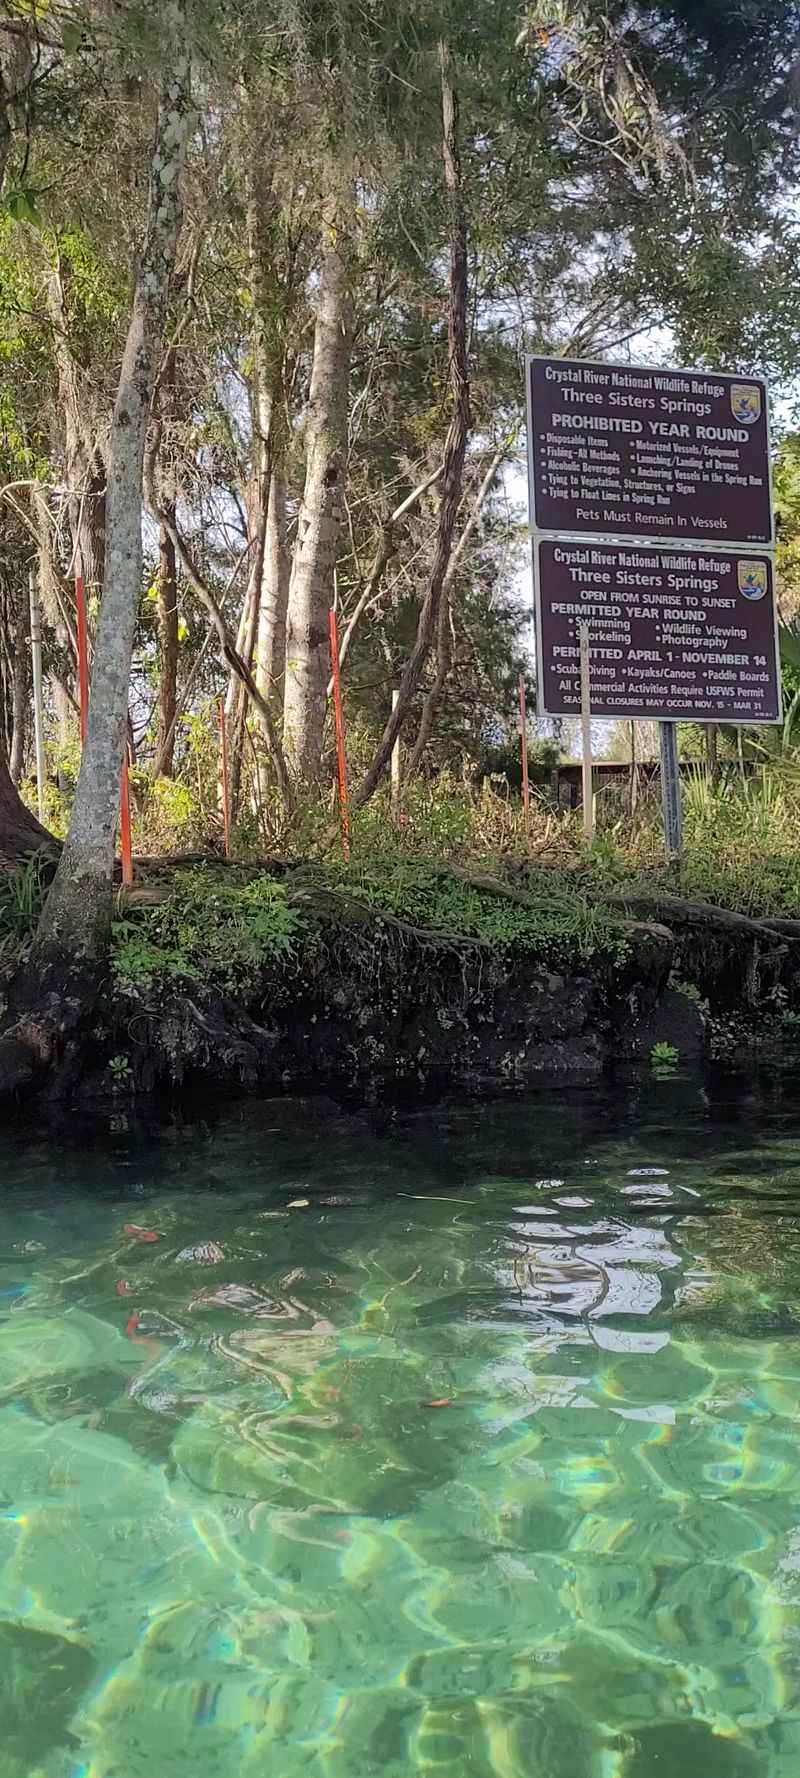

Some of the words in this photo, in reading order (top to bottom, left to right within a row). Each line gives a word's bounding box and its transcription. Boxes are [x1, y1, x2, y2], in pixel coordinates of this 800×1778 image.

[545, 366, 581, 382] Crystal
[584, 370, 609, 384] River
[612, 373, 652, 389] National
[654, 377, 690, 392] Wildlife
[692, 381, 724, 397] Refuge
[561, 388, 602, 404] Three
[608, 392, 655, 408] Sisters
[660, 397, 711, 416] Springs
[552, 414, 643, 433] PROHIBITED
[648, 421, 690, 437] YEAR
[696, 426, 749, 442] ROUND
[546, 432, 586, 445] Disposable
[588, 436, 608, 446] Items
[590, 449, 620, 461] Methods
[636, 440, 671, 452] Motorized
[673, 443, 740, 458] Vessels/Equipment
[548, 460, 580, 471] Alcoholic
[583, 463, 620, 475] Beverages
[637, 453, 703, 470] Launching/Landing
[705, 459, 712, 468] of
[715, 460, 738, 470] Drones
[548, 473, 568, 485] Tying
[571, 476, 578, 484] to
[581, 476, 621, 489] Vegetation,
[676, 483, 695, 494] Signs
[638, 467, 672, 480] Anchoring
[674, 470, 700, 480] Vessels
[702, 472, 709, 481] in
[711, 473, 723, 482] the
[725, 473, 747, 486] Spring
[749, 475, 762, 485] Run
[549, 487, 568, 499] Tying
[571, 489, 579, 498] to
[581, 489, 600, 500] Float
[602, 491, 620, 501] Lines
[623, 492, 630, 502] in
[632, 492, 655, 505] Spring
[657, 495, 670, 504] Run
[576, 508, 600, 520] Pets
[604, 510, 631, 522] Must
[635, 512, 673, 525] Remain
[678, 516, 687, 526] In
[690, 516, 727, 528] Vessels
[554, 548, 589, 564] Crystal
[591, 551, 616, 565] River
[619, 553, 659, 568] National
[661, 556, 696, 570] Wildlife
[699, 558, 731, 574] Refuge
[569, 568, 610, 583] Three
[616, 571, 662, 586] Sisters
[668, 574, 718, 592] Springs
[581, 590, 606, 600] OPEN
[611, 592, 639, 602] FROM
[642, 594, 680, 605] SUNRISE
[685, 596, 698, 606] TO
[702, 598, 736, 608] SUNSET
[551, 603, 621, 616] PERMITTED
[626, 606, 658, 618] YEAR
[664, 609, 706, 621] ROUND
[576, 616, 630, 631] Swimming
[662, 623, 701, 634] Wildlife
[705, 626, 746, 639] Viewing
[576, 630, 631, 644] Sorkeling
[662, 634, 728, 649] Photography
[553, 646, 623, 659] PERITTED
[627, 650, 662, 661] APRIL
[682, 652, 749, 665] NOVEMBER
[753, 656, 766, 666] 14
[587, 665, 615, 678] Diving
[627, 667, 696, 679] Kayaks/Canoes
[708, 670, 737, 680] Paddle
[740, 671, 769, 681] Boards
[559, 680, 570, 690] All
[575, 682, 625, 692] Cmmercial
[628, 683, 668, 694] Activities
[671, 685, 703, 696] Require
[738, 687, 764, 697] Permit
[563, 696, 605, 704] SEASNAL
[607, 697, 643, 706] CLOSURES
